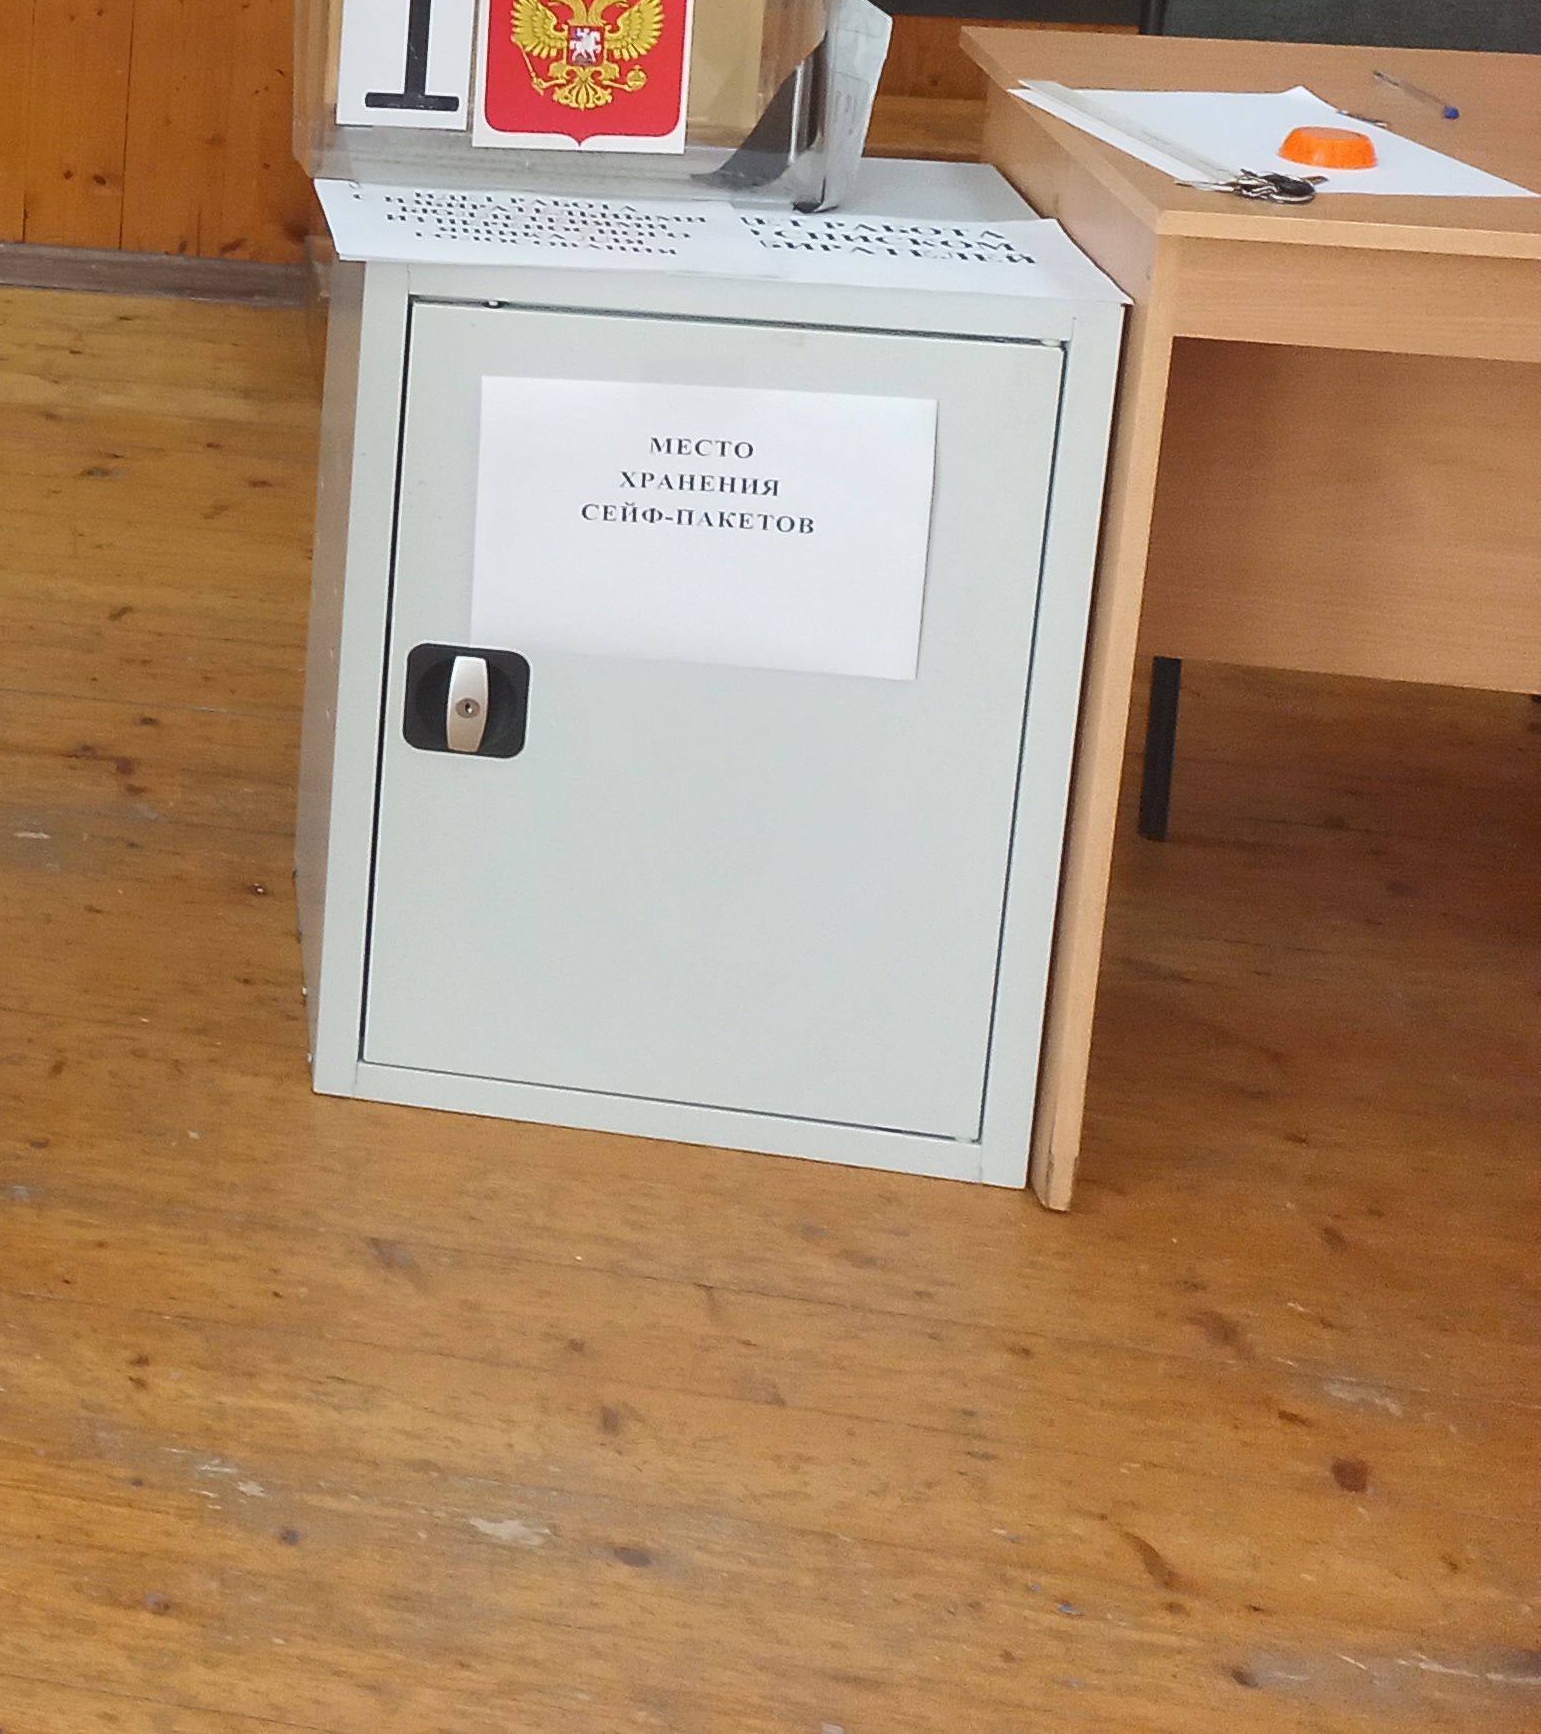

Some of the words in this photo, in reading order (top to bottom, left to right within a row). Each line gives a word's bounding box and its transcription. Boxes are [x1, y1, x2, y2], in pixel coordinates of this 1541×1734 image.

[759, 238, 1038, 265] БИРАТЕЛЕЙ
[650, 437, 754, 459] МЕСТО
[619, 471, 780, 497] ХРАНЕНИЯ
[581, 502, 814, 535] СЕЙФ-ПАКЕТОВ
